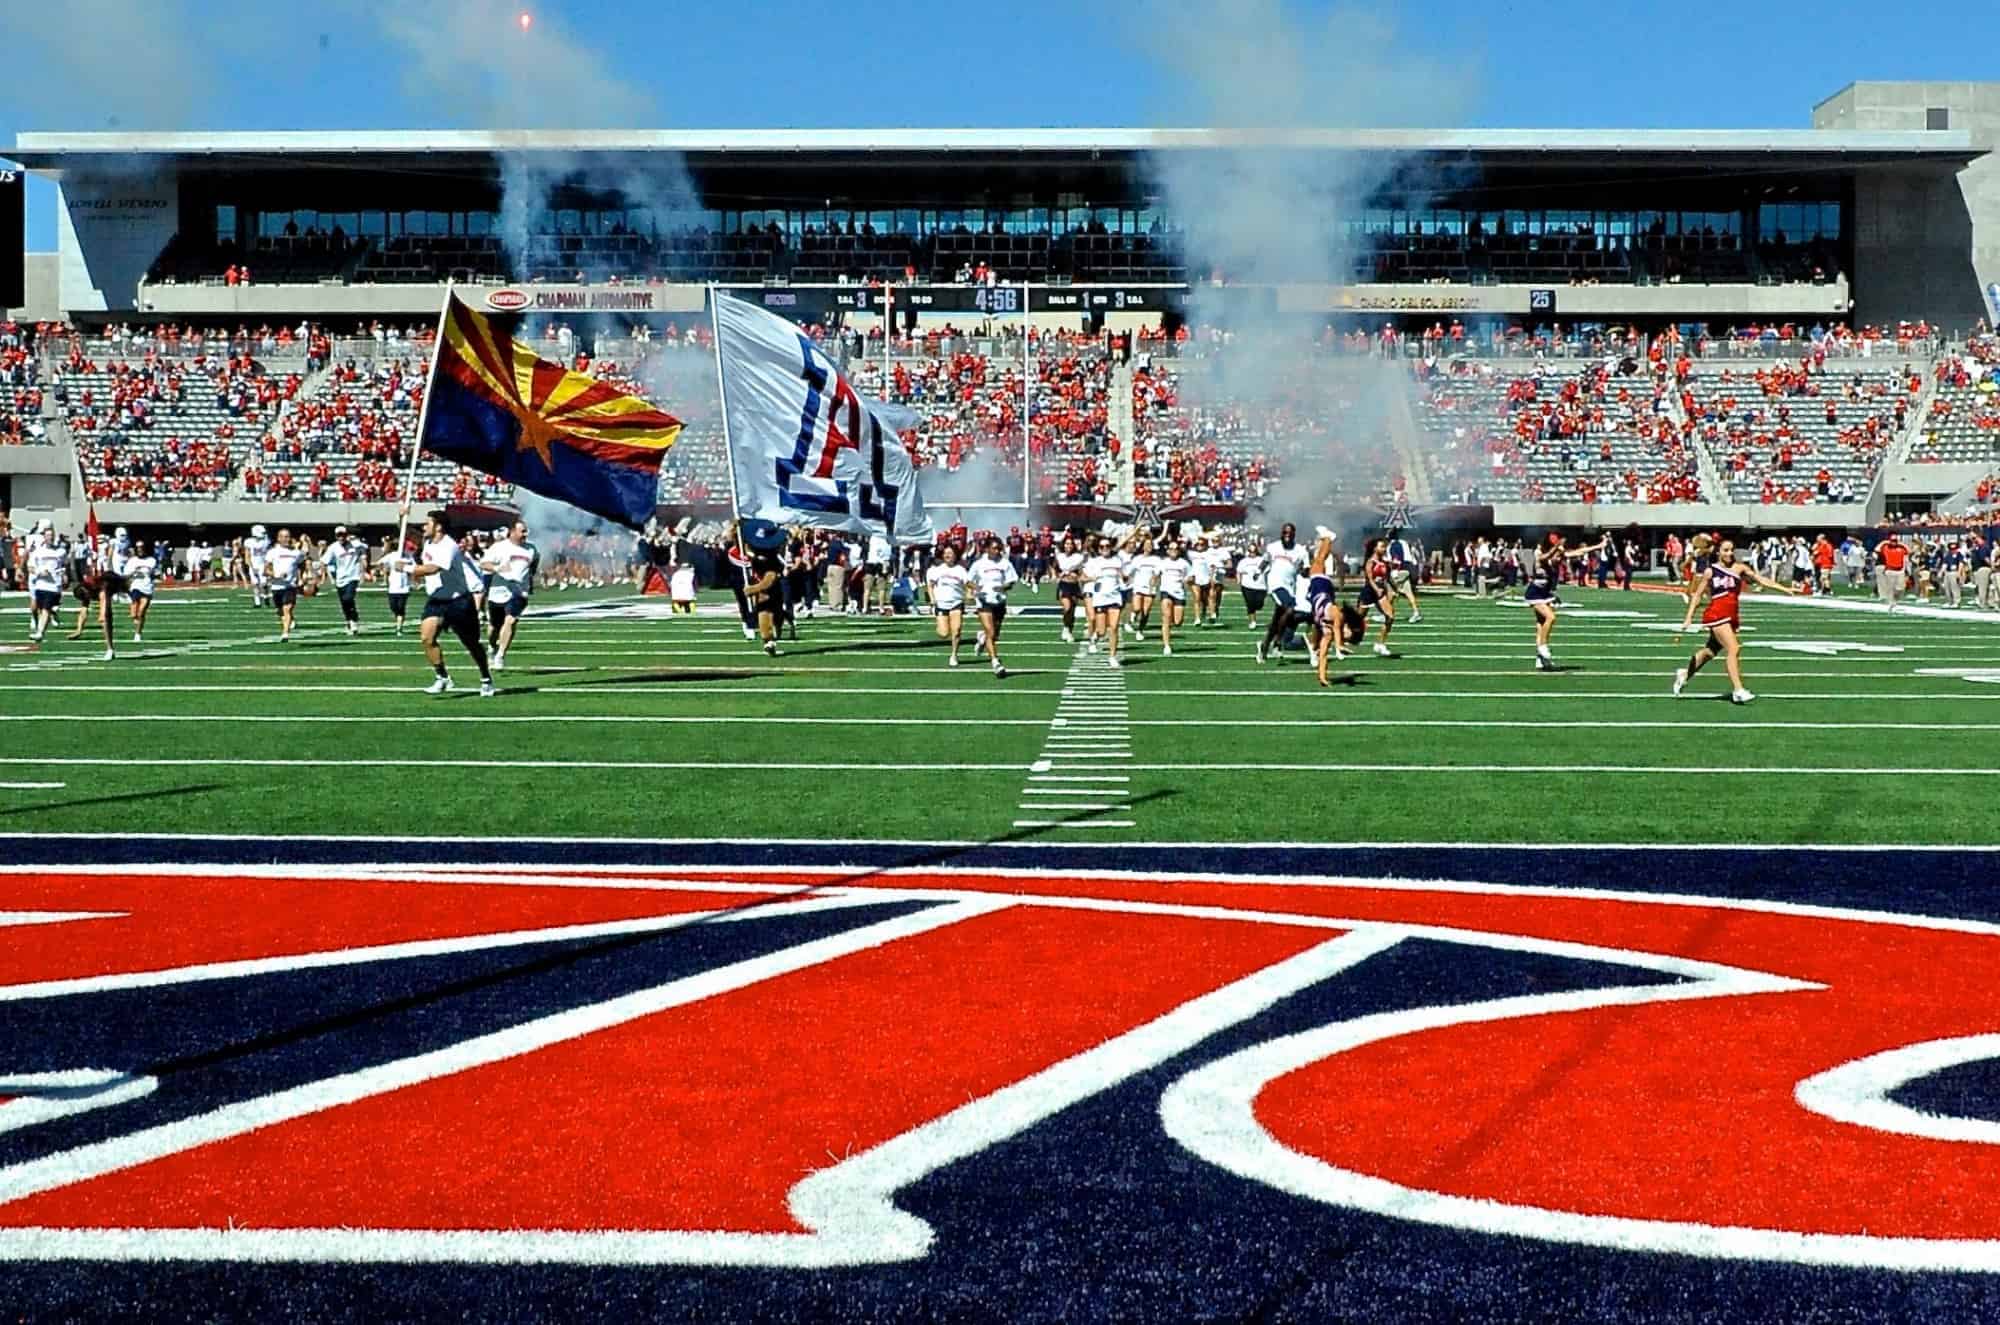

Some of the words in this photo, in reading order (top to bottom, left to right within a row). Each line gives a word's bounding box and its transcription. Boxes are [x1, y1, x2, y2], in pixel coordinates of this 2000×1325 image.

[537, 292, 585, 309] CHAPMAN
[591, 292, 655, 309] AUTOMOTIVE
[975, 289, 1017, 311] 4:56
[1082, 291, 1090, 309] 1
[1114, 291, 1125, 308] 3
[1532, 291, 1550, 308] 25
